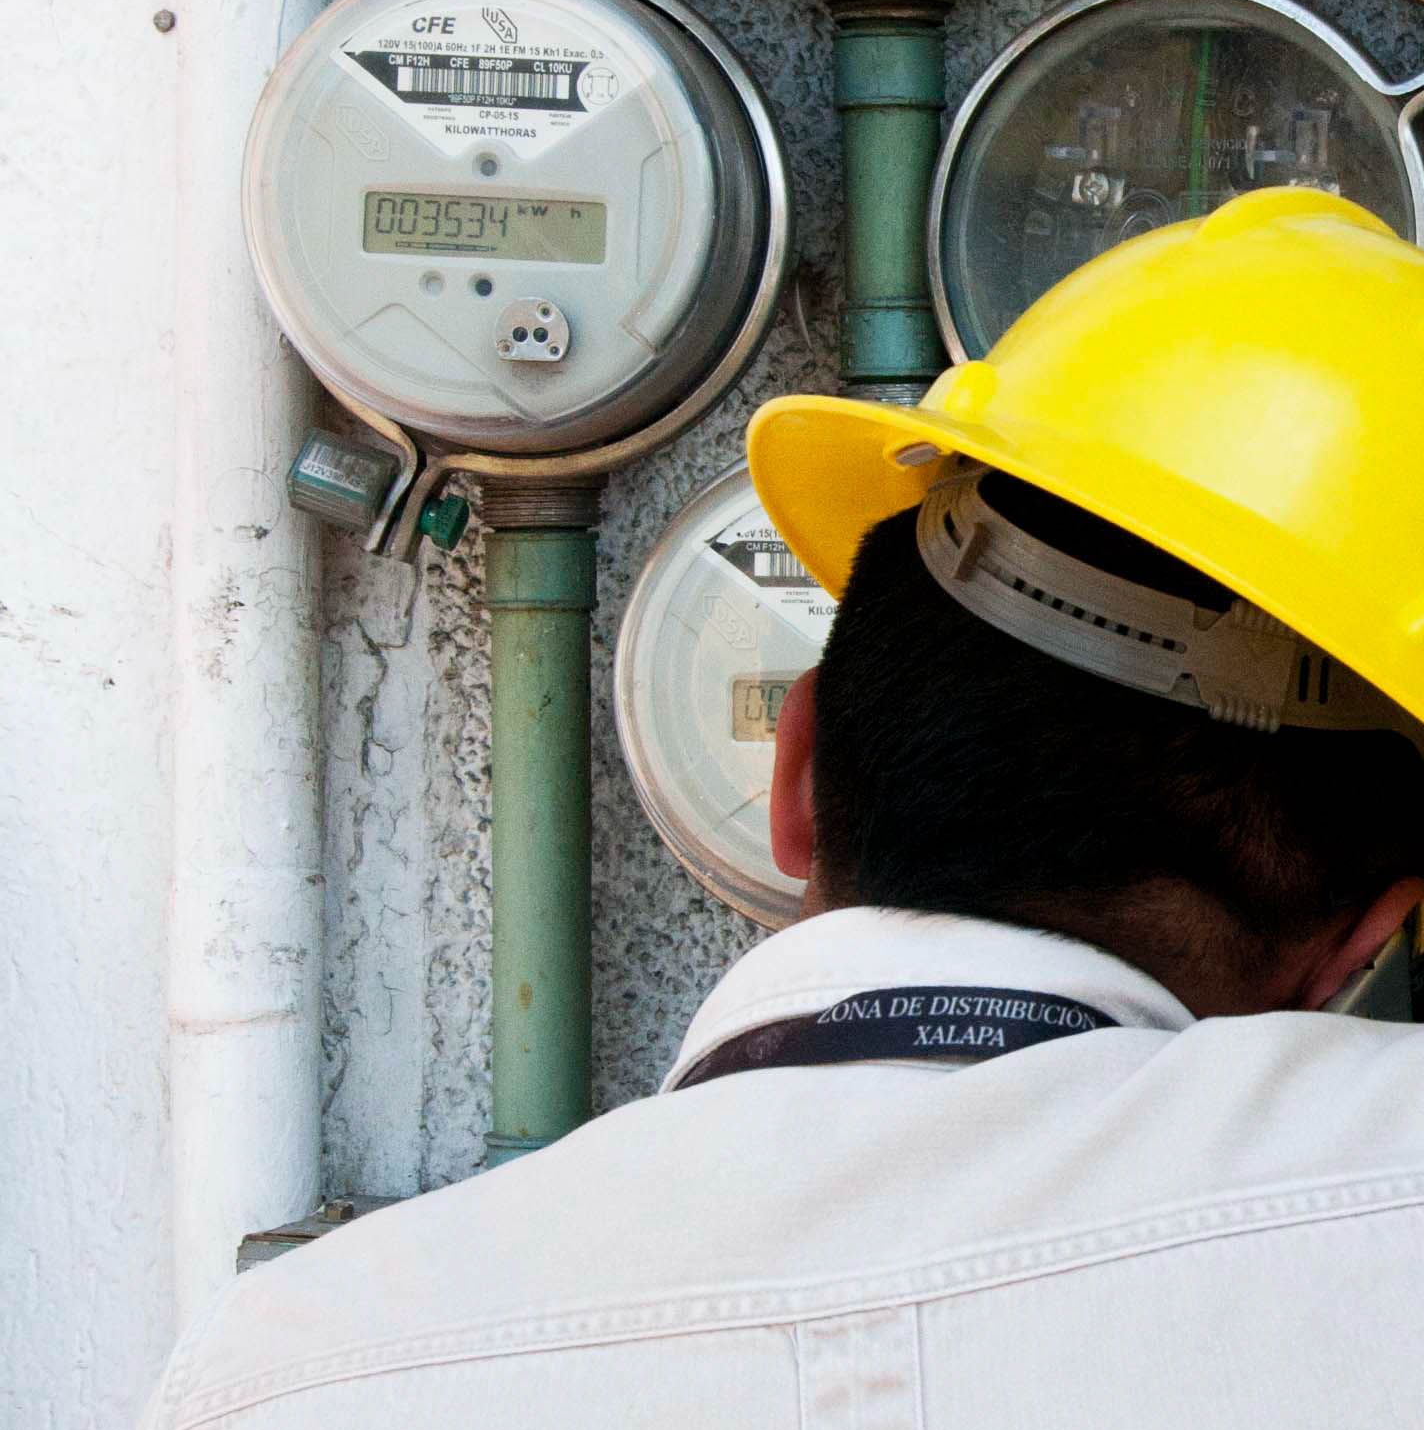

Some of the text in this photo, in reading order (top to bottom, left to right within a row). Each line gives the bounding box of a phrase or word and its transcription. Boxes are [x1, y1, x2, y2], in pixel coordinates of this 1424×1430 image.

[412, 16, 456, 35] CFE
[484, 9, 513, 40] IUSA
[378, 39, 400, 49] 120V
[445, 42, 468, 51] 60Hz
[484, 44, 496, 53] 2H
[500, 45, 510, 54] 1E
[513, 46, 526, 55] FM
[543, 47, 560, 57] Kh1
[388, 53, 431, 66] CM F12H
[449, 57, 470, 68] CFE
[533, 61, 573, 73] CL 10KU
[445, 125, 537, 138] KILOWATTHORAS
[375, 197, 508, 238] 003534
[746, 542, 785, 551] CM F12H
[817, 999, 882, 1024] ZONA
[889, 997, 924, 1016] DE
[913, 1026, 1006, 1047] XALAPA
